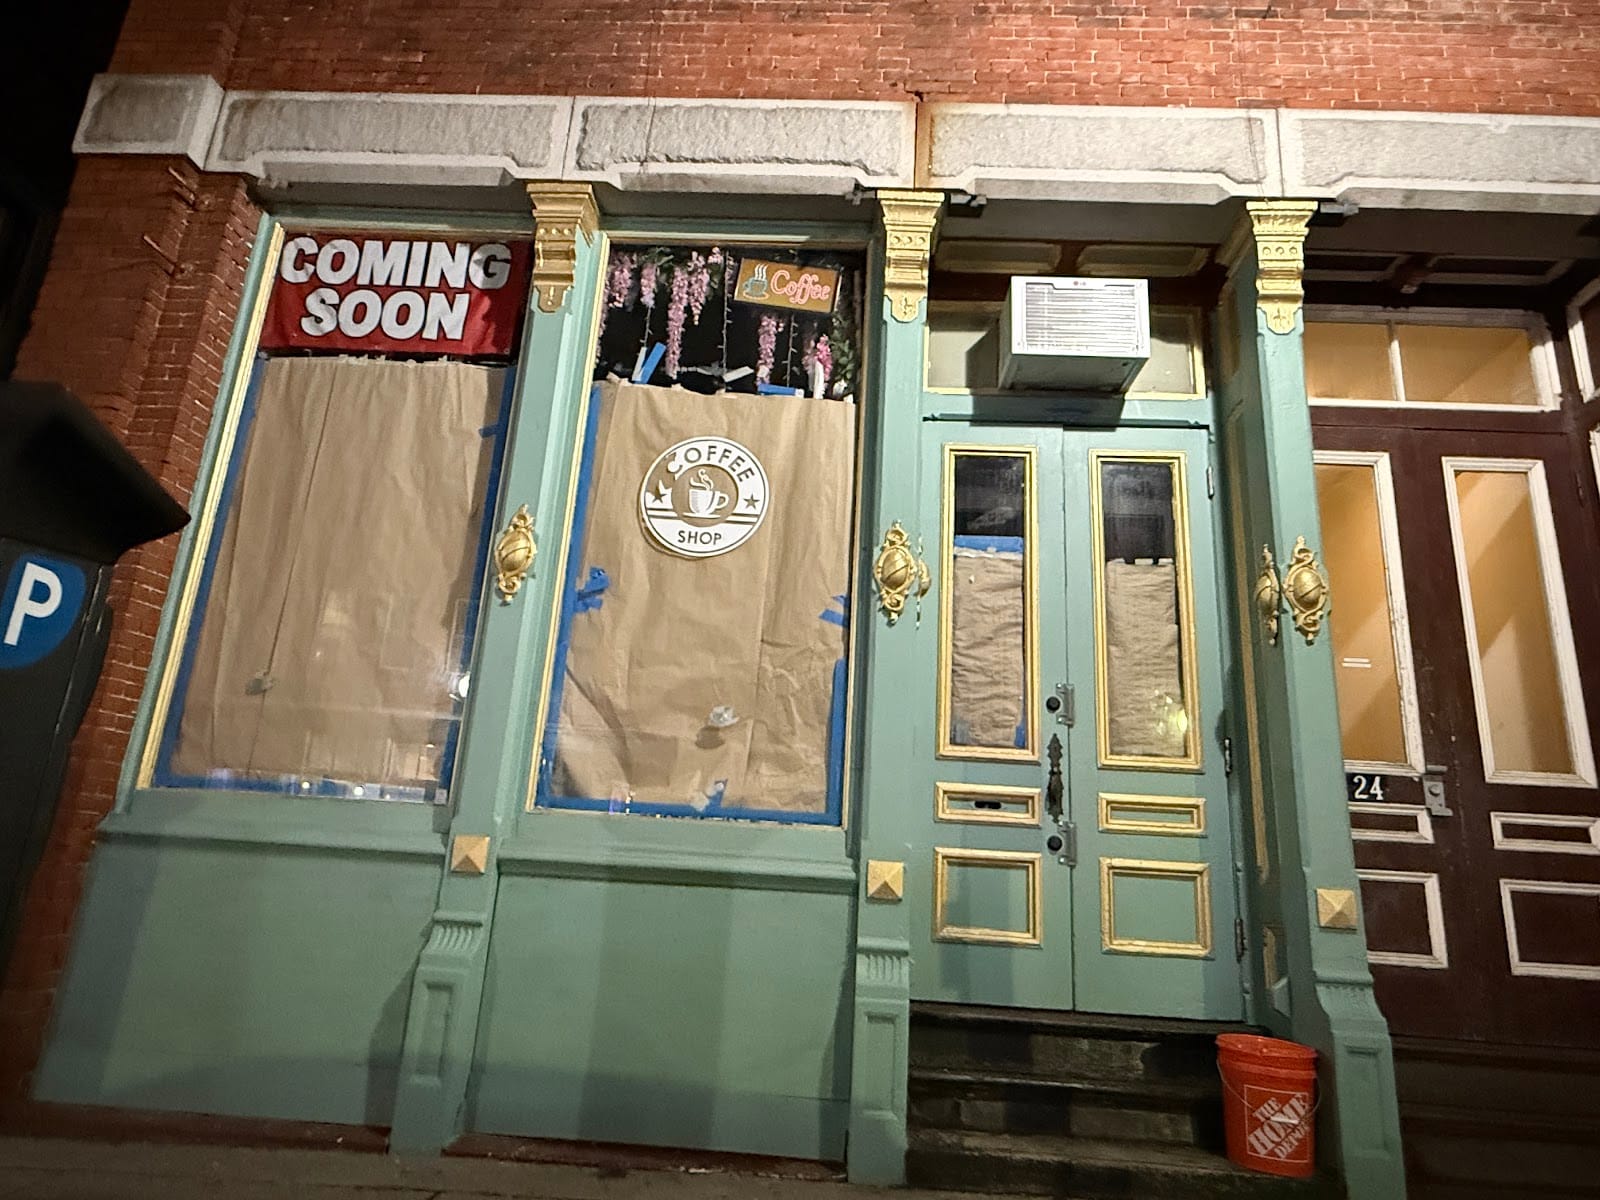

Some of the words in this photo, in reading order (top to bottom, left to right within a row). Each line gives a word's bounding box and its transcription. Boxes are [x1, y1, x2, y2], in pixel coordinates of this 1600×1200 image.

[280, 237, 512, 290] COMING
[770, 270, 831, 305] Coffee
[301, 287, 470, 341] SOON
[667, 445, 755, 482] COFFEE
[678, 530, 722, 545] SHOP
[3, 562, 63, 646] P
[1353, 775, 1384, 800] 24
[1252, 1097, 1282, 1122] THE
